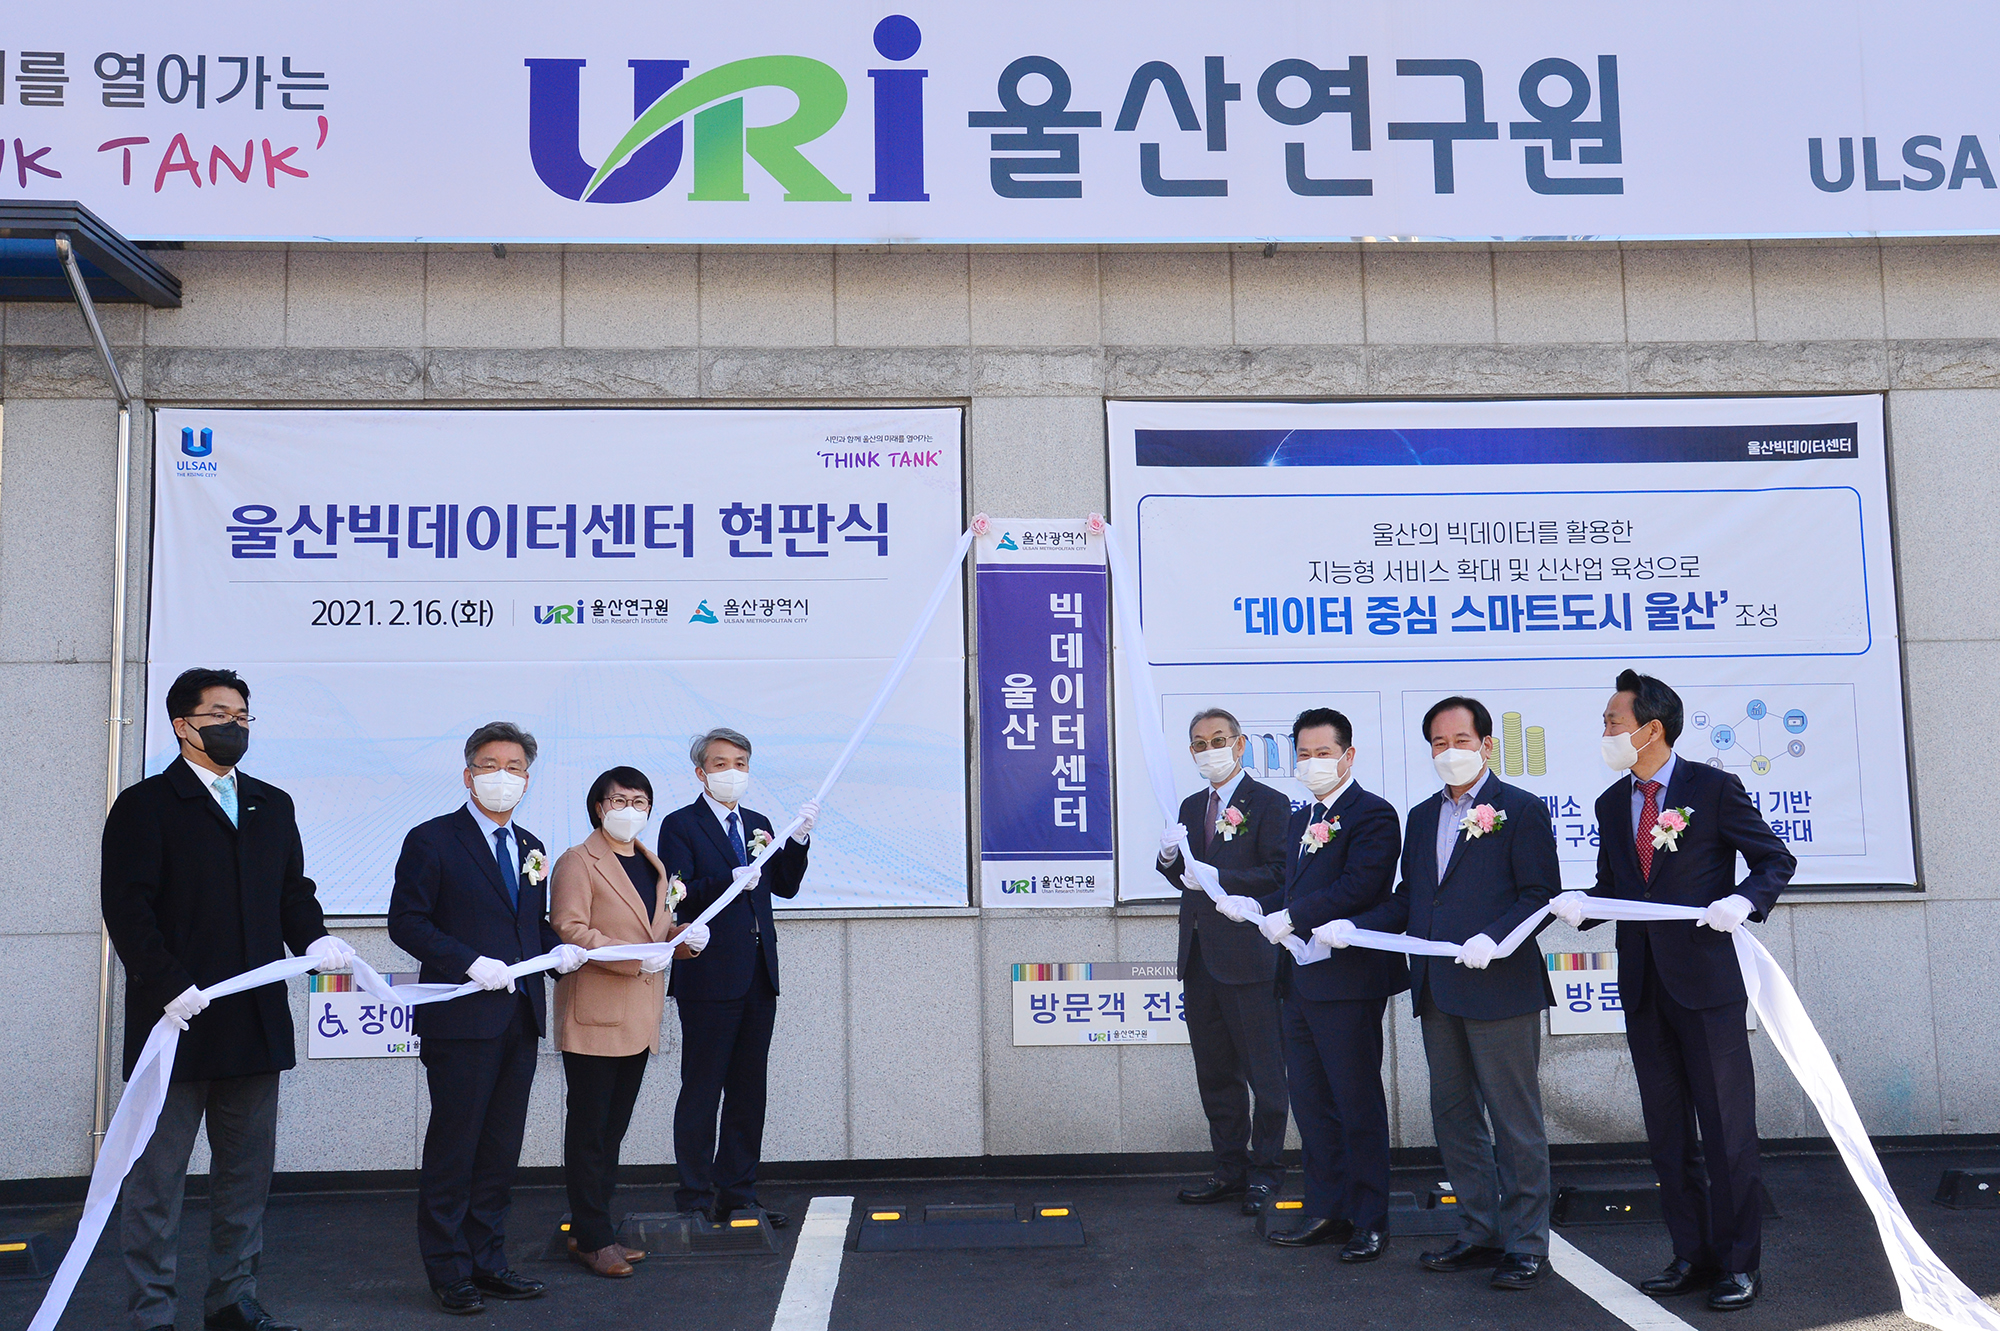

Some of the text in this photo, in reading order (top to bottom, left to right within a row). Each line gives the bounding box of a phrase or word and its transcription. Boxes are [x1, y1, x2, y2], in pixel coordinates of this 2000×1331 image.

[0, 50, 330, 111] 를 열어가는
[524, 14, 1624, 204] URi 울산연구원
[0, 138, 62, 188] K
[1808, 133, 2000, 193] ULSA
[863, 434, 883, 443] 울산의
[884, 434, 905, 443] 미래를
[906, 434, 933, 443] 열어가는
[1747, 437, 1852, 455] 울산빅데이터센터
[177, 461, 217, 471] ULSAN
[226, 502, 888, 559] 울산빅데이터센터 현판식
[1022, 531, 1087, 546] 울산광역시
[1373, 519, 1633, 547] 울산의 빅데이터를 활용한
[1308, 555, 1700, 585] 지능형 서비스 확대 및 신산업 육성으로
[311, 599, 494, 628] 2021. 2.16.(화)
[534, 599, 668, 625] URi 울산연구원
[723, 598, 808, 617] 울산광역시
[1366, 595, 1438, 635] 중심
[1451, 592, 1632, 634] 스마트도시
[1735, 603, 1779, 628] 조성
[1001, 673, 1039, 751] 울산
[1049, 592, 1087, 832] 빅데이터센터
[1769, 791, 1812, 813] 기반
[1771, 820, 1813, 843] 확대
[1001, 875, 1095, 894] URi 울산연구원
[1030, 992, 1125, 1024] 방문객
[387, 1040, 410, 1053] URi
[1089, 1029, 1148, 1042] URi 울산연구원
